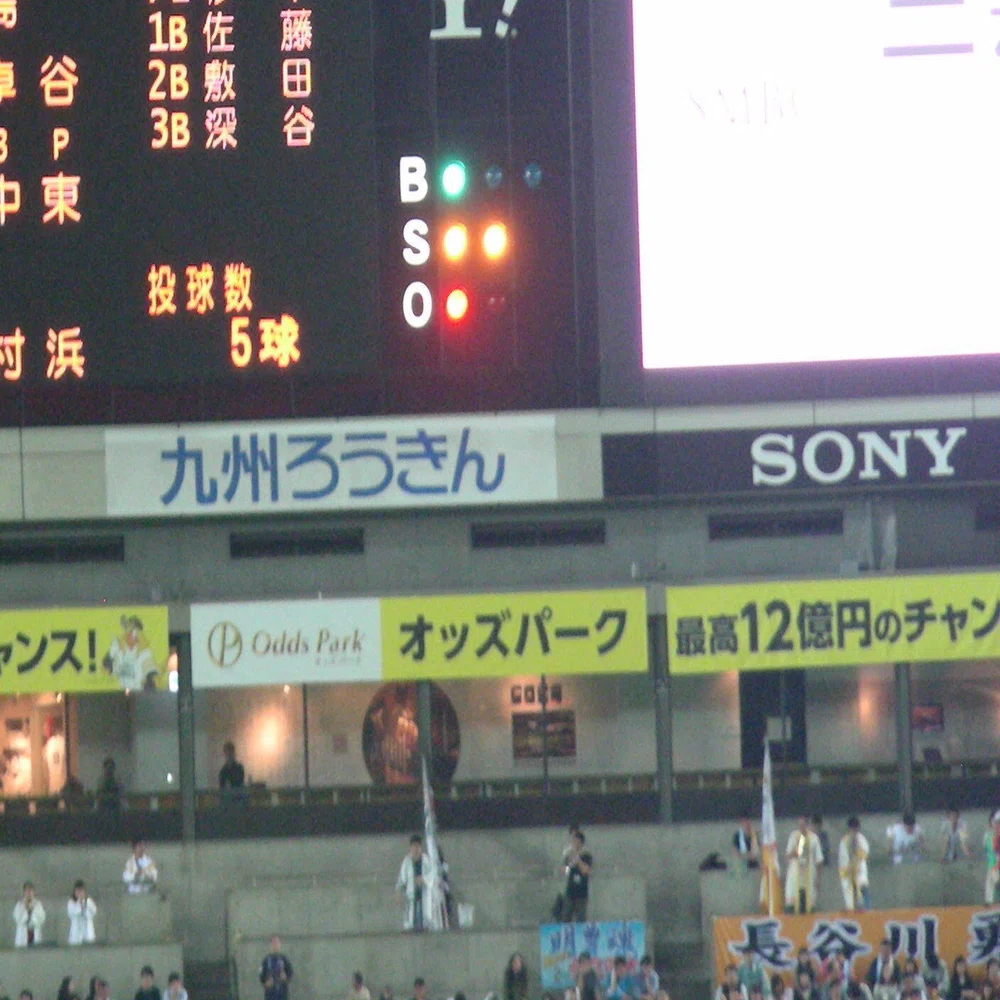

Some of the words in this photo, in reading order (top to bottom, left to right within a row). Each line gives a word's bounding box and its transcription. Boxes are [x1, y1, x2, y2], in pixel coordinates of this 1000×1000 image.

[149, 11, 188, 52] 1B
[148, 59, 189, 101] 2B
[53, 127, 69, 161] P
[151, 107, 190, 149] 3B
[400, 156, 428, 203] B
[403, 219, 430, 266] S
[403, 281, 432, 329] O
[160, 428, 506, 505] 九州ろうきん
[750, 427, 967, 486] SONY
[252, 629, 309, 656] Odds
[316, 627, 369, 653] Park
[400, 605, 627, 660] オッズパーク
